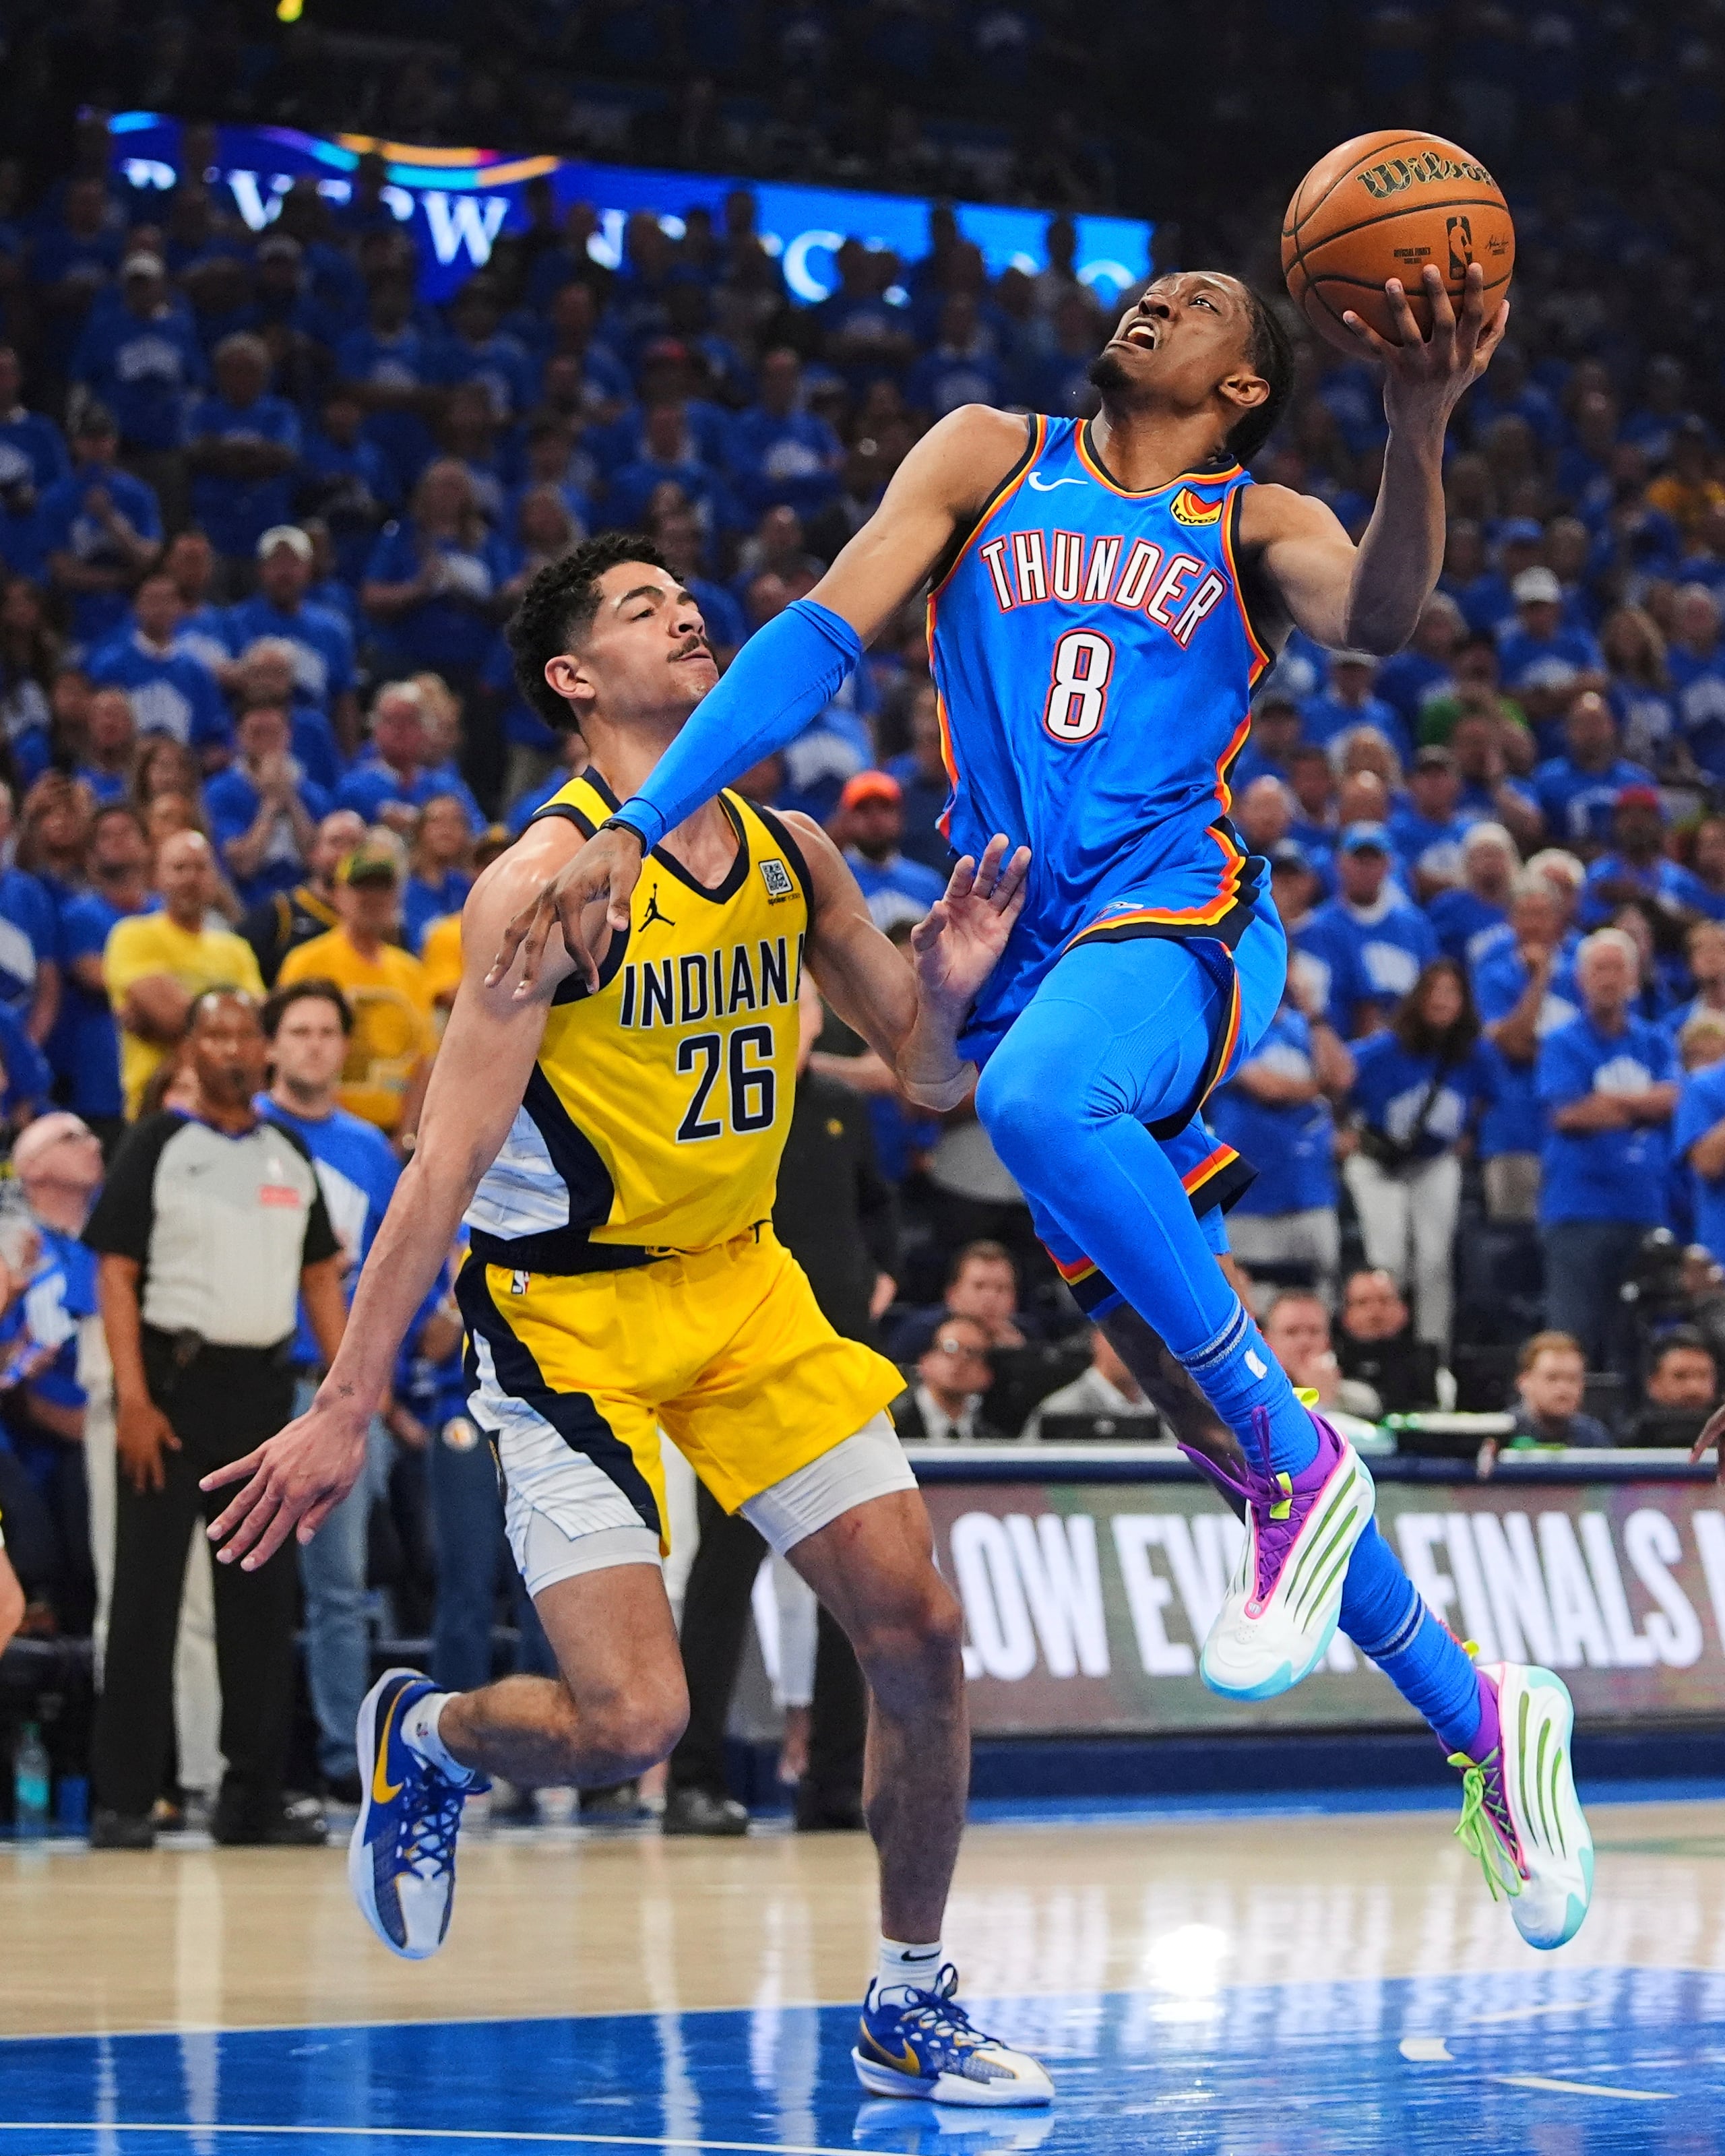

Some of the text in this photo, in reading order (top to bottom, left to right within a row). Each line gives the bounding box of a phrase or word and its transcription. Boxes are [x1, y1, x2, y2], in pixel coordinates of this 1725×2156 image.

[1355, 151, 1498, 199] Wilson
[979, 528, 1228, 651] THUNDER
[1043, 628, 1116, 744] 8
[676, 1023, 776, 1144] 26
[1395, 1509, 1703, 1669] FINALS
